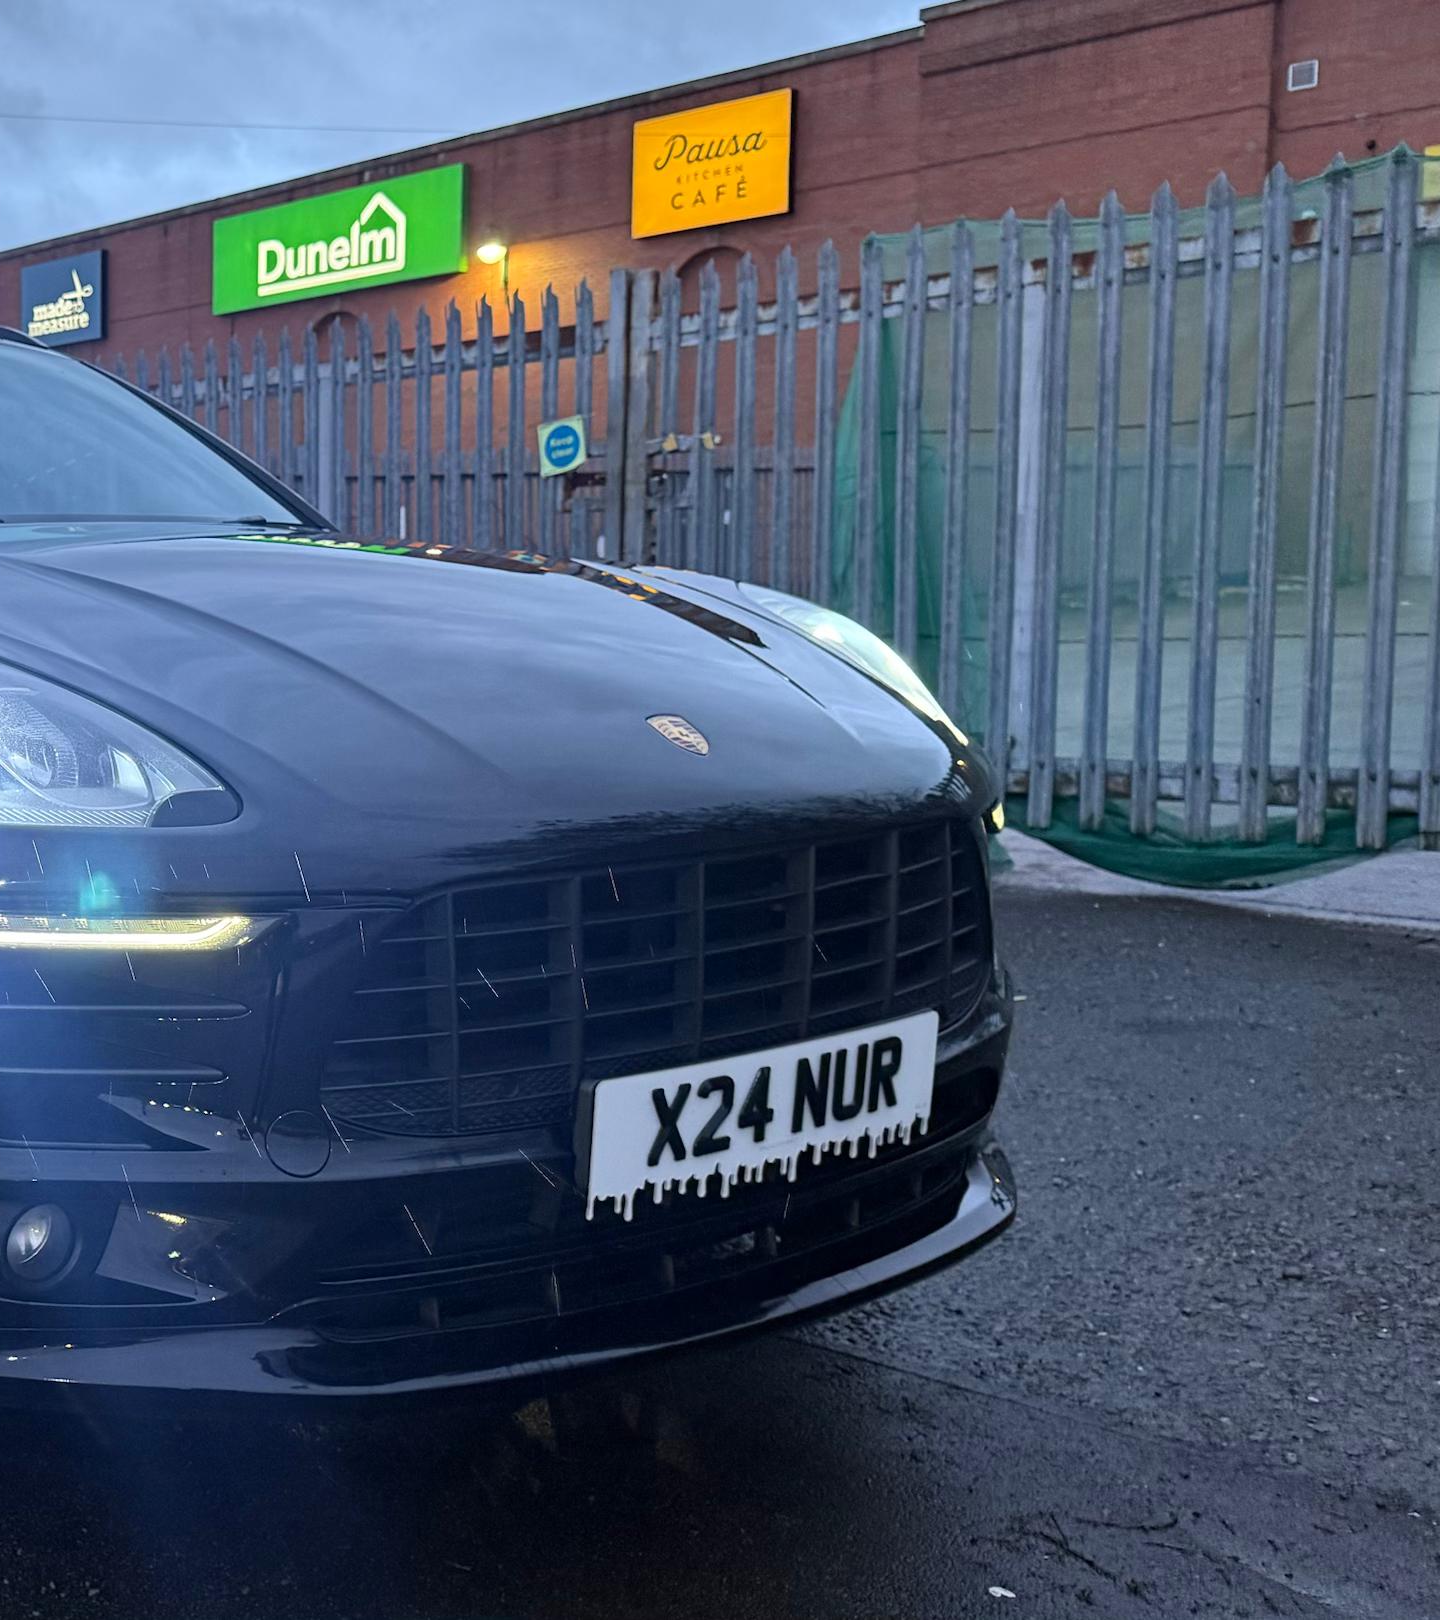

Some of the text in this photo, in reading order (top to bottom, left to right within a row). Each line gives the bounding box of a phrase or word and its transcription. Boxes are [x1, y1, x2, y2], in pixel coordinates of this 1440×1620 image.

[654, 131, 767, 171] Pausa
[671, 175, 748, 210] CAFÉ
[676, 164, 744, 185] KITCHEN
[257, 219, 396, 285] Dunelm
[647, 1036, 903, 1167] X24 NUR
